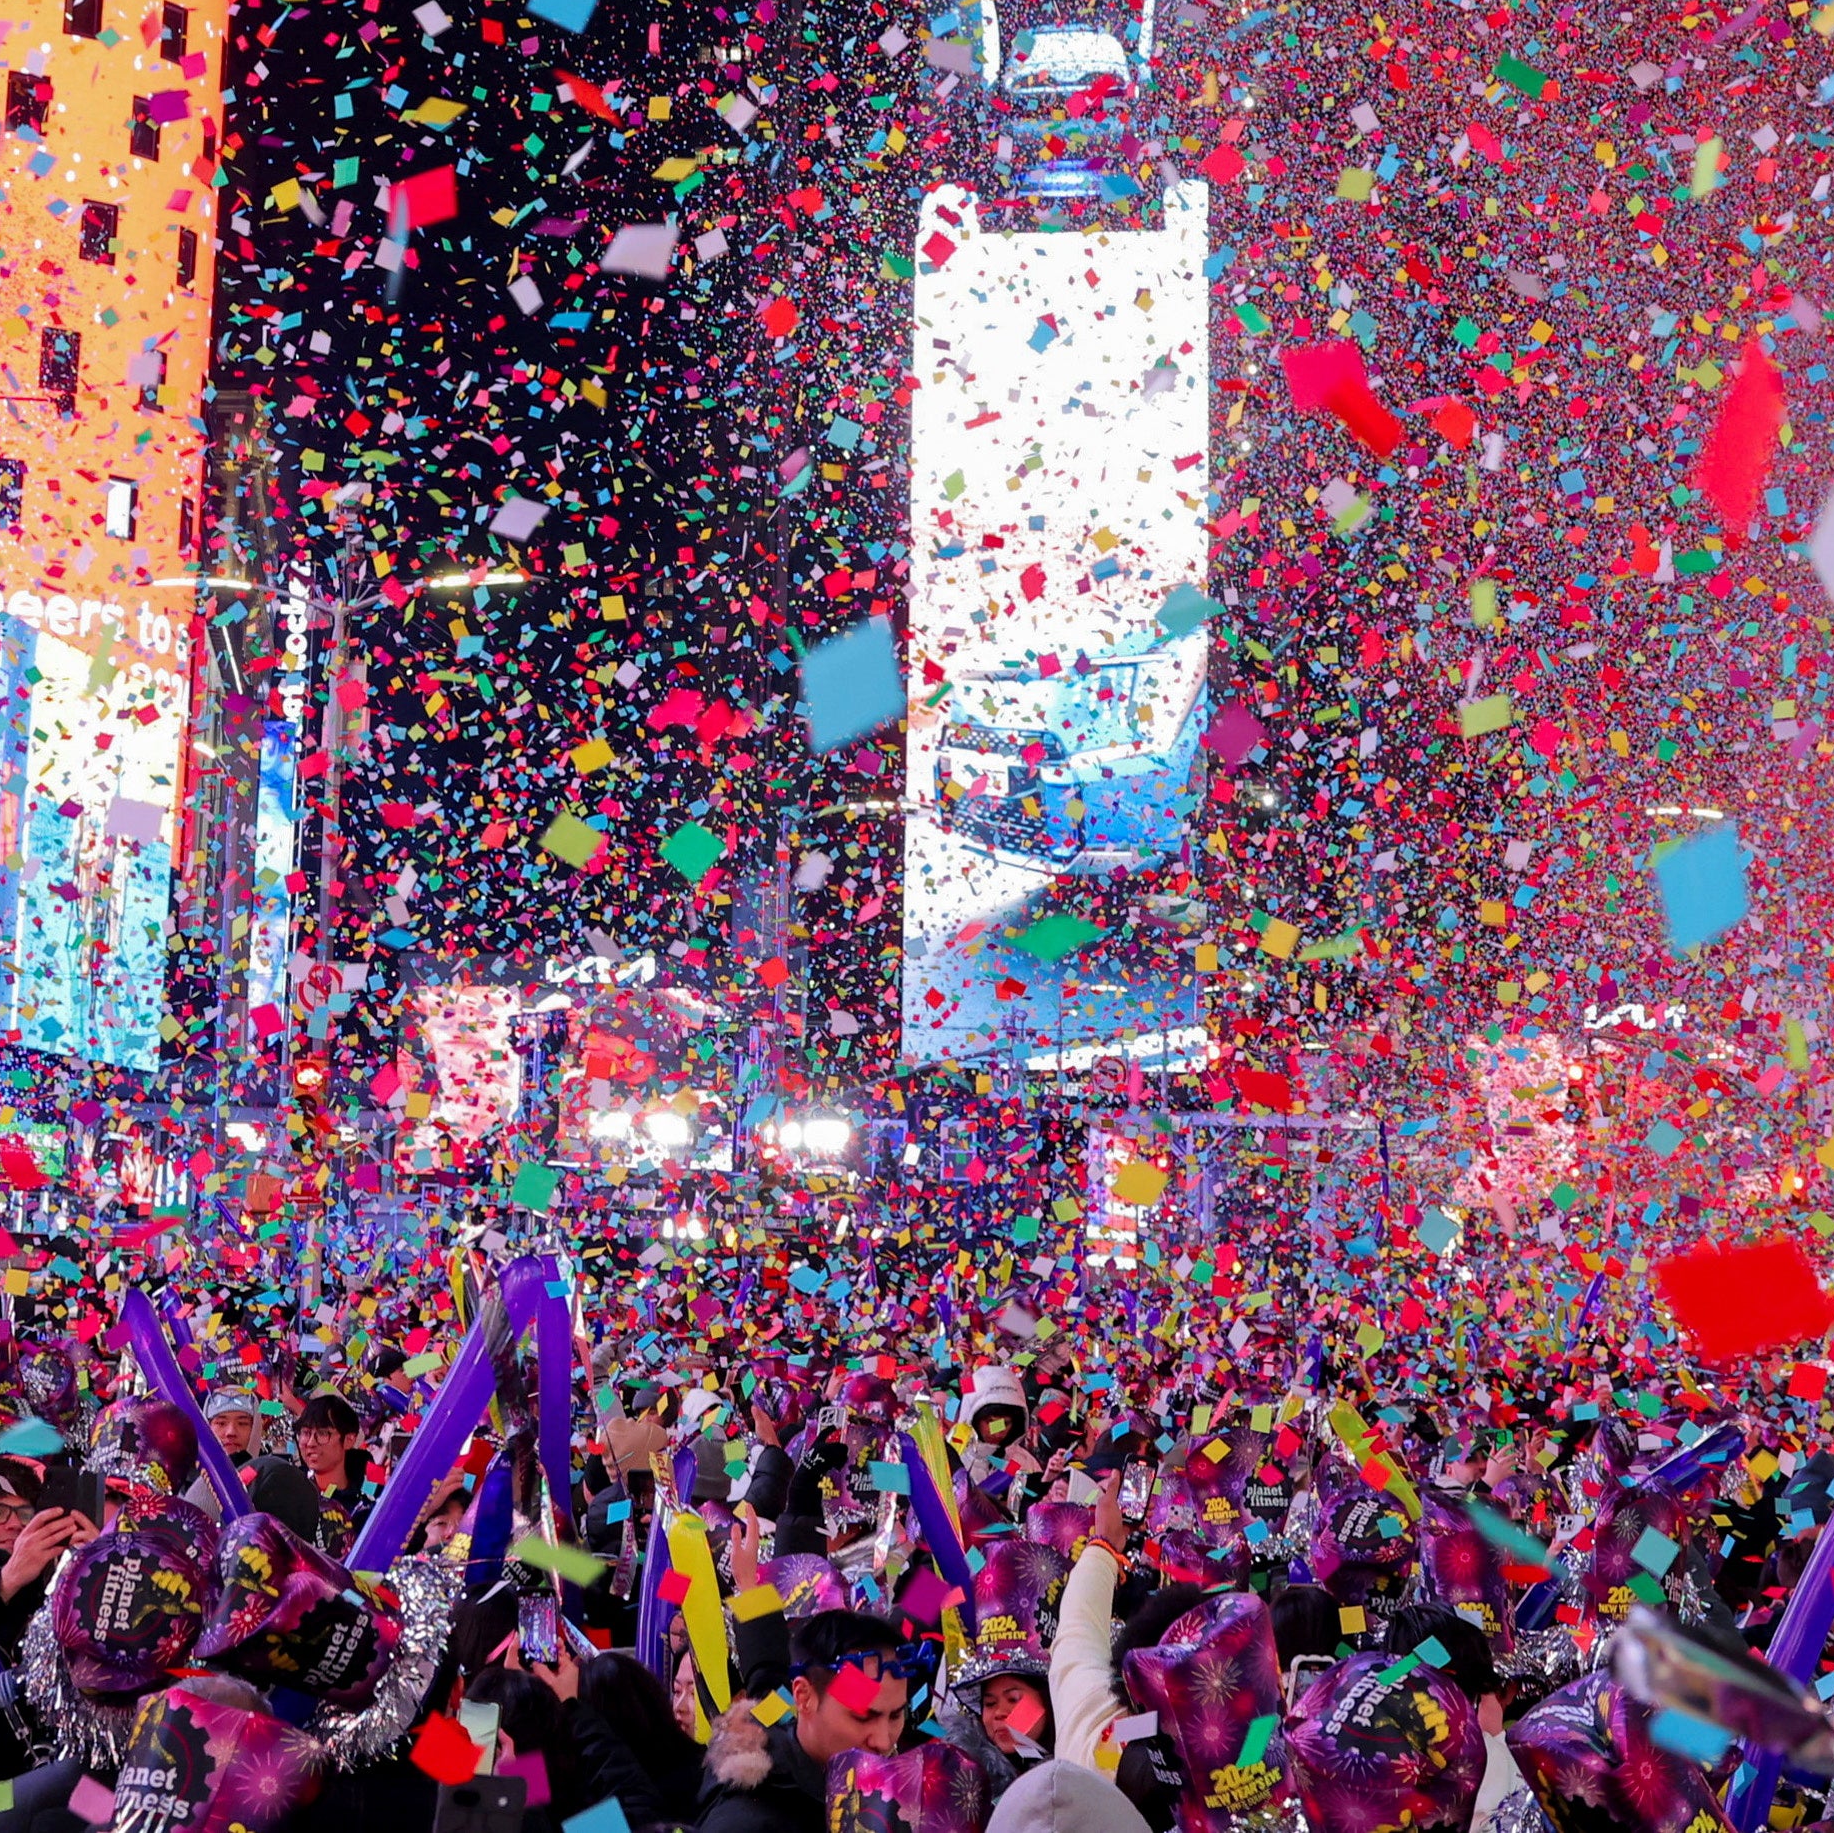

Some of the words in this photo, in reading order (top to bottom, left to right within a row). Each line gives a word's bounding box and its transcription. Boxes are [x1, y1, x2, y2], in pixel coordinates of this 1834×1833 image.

[138, 599, 172, 655] to
[1205, 1497, 1232, 1512] 2024
[1246, 1482, 1285, 1499] planet
[1251, 1494, 1291, 1509] fitness
[93, 1563, 130, 1642] fitness
[114, 1555, 148, 1631] planet
[980, 1616, 1018, 1632] 2024
[303, 1622, 353, 1686] planet
[319, 1612, 371, 1689] fitness
[1204, 1793, 1230, 1809] NEW
[1228, 1778, 1264, 1803] YEAR'S
[1261, 1767, 1285, 1788] EVE
[1210, 1761, 1269, 1794] 2024
